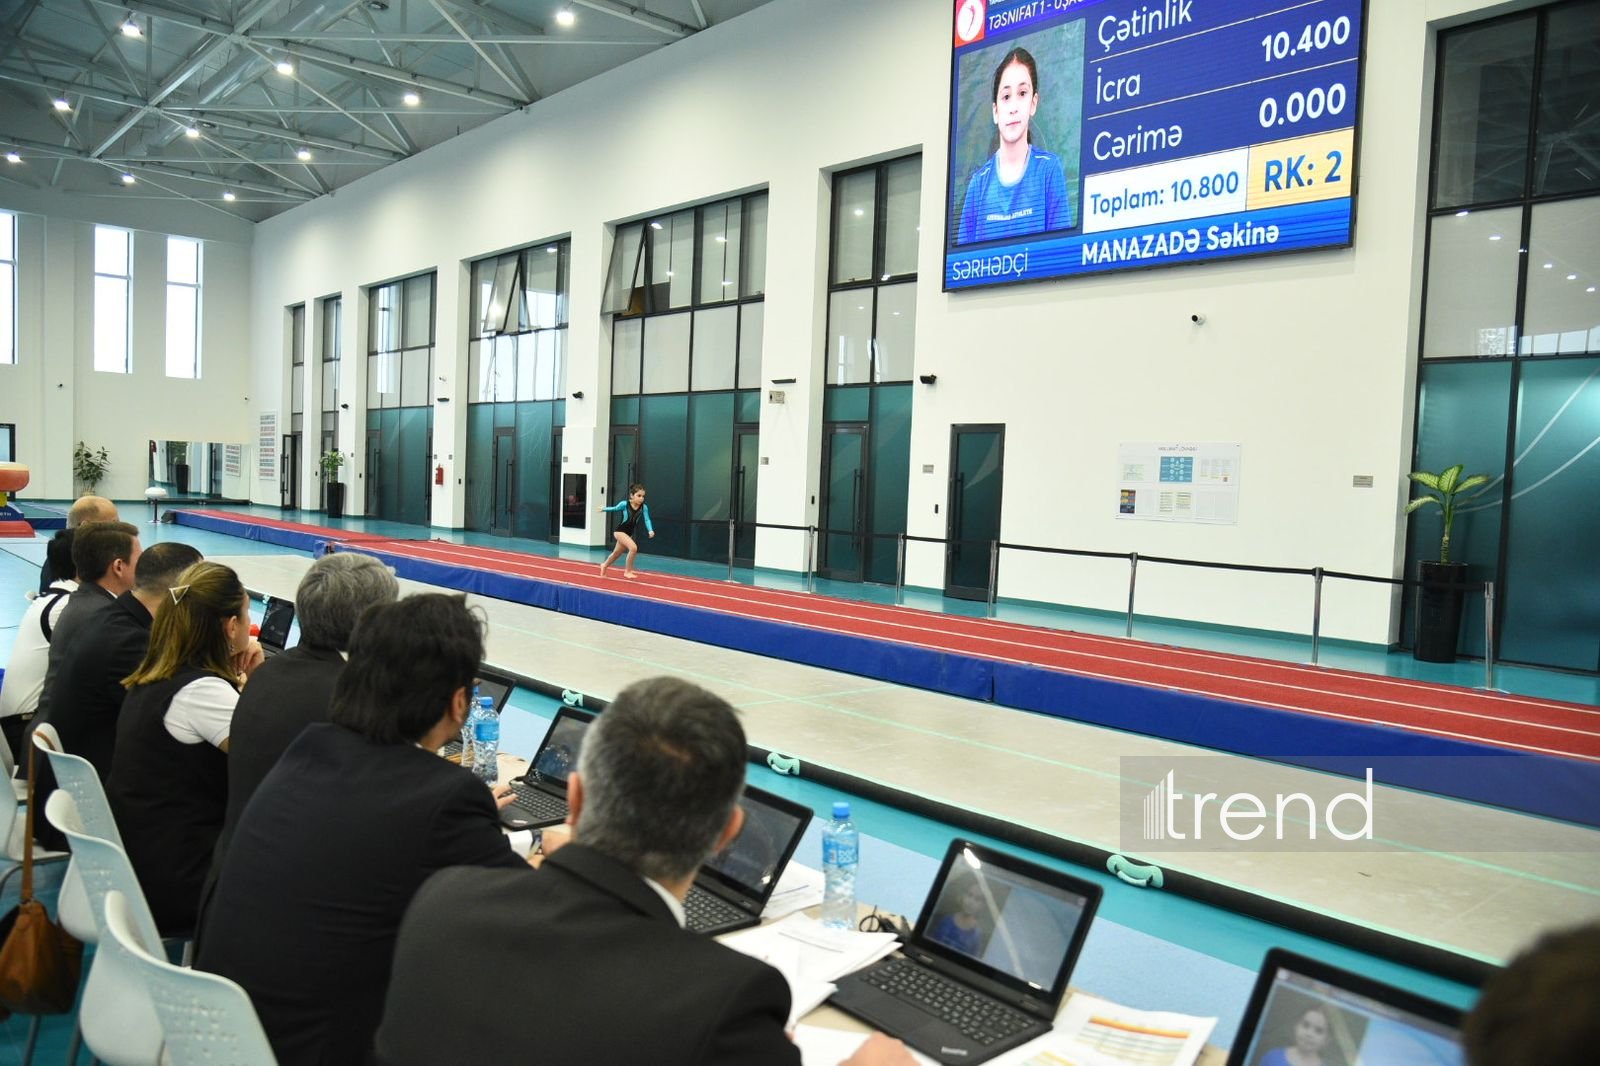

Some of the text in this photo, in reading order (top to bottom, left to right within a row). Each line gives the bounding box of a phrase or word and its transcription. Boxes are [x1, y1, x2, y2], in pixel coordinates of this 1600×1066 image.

[1098, 0, 1193, 53] Çətinlik
[1096, 15, 1351, 105] İcra 10.400
[1093, 83, 1346, 161] Cərimə 0.000
[1090, 171, 1239, 218] Toplam: 10.800
[1264, 150, 1342, 193] RK: 2
[952, 247, 1029, 280] SƏRHƏDÇİ
[1081, 221, 1280, 266] MANAZADƏ Səkinə
